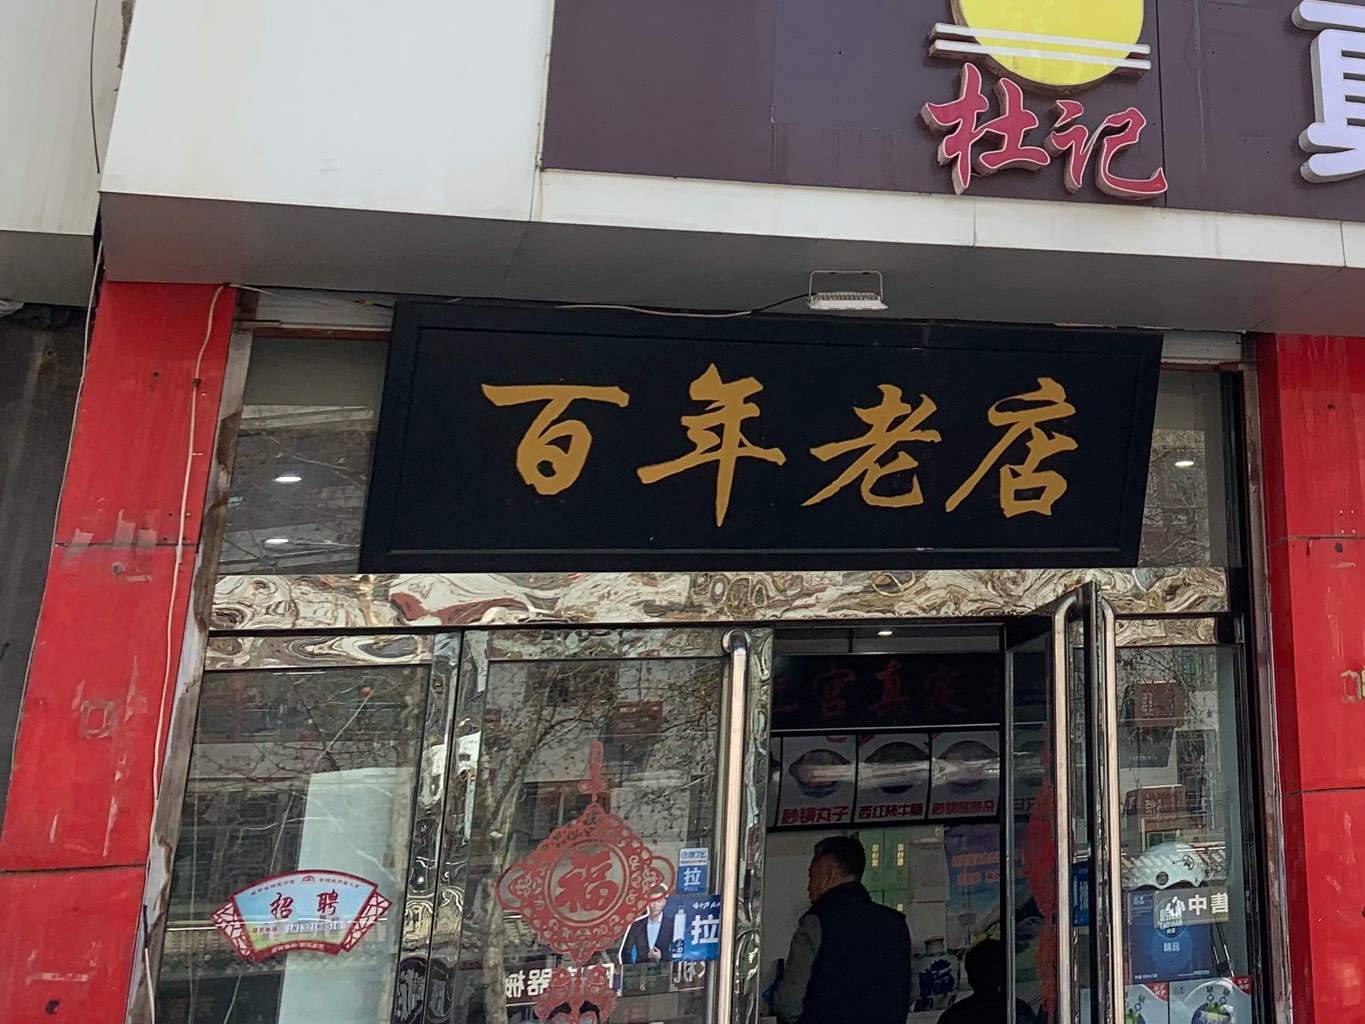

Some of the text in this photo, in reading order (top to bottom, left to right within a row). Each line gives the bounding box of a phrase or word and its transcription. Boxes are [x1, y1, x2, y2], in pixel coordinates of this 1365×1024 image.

[920, 62, 1168, 200] 杜记
[481, 363, 1079, 527] 百年老店
[782, 806, 848, 824] 砂锅丸子
[858, 804, 924, 819] 西红柿牛腩
[554, 850, 619, 914] 福
[684, 867, 702, 886] 拉
[269, 888, 339, 920] 招聘
[691, 914, 720, 945] 拉
